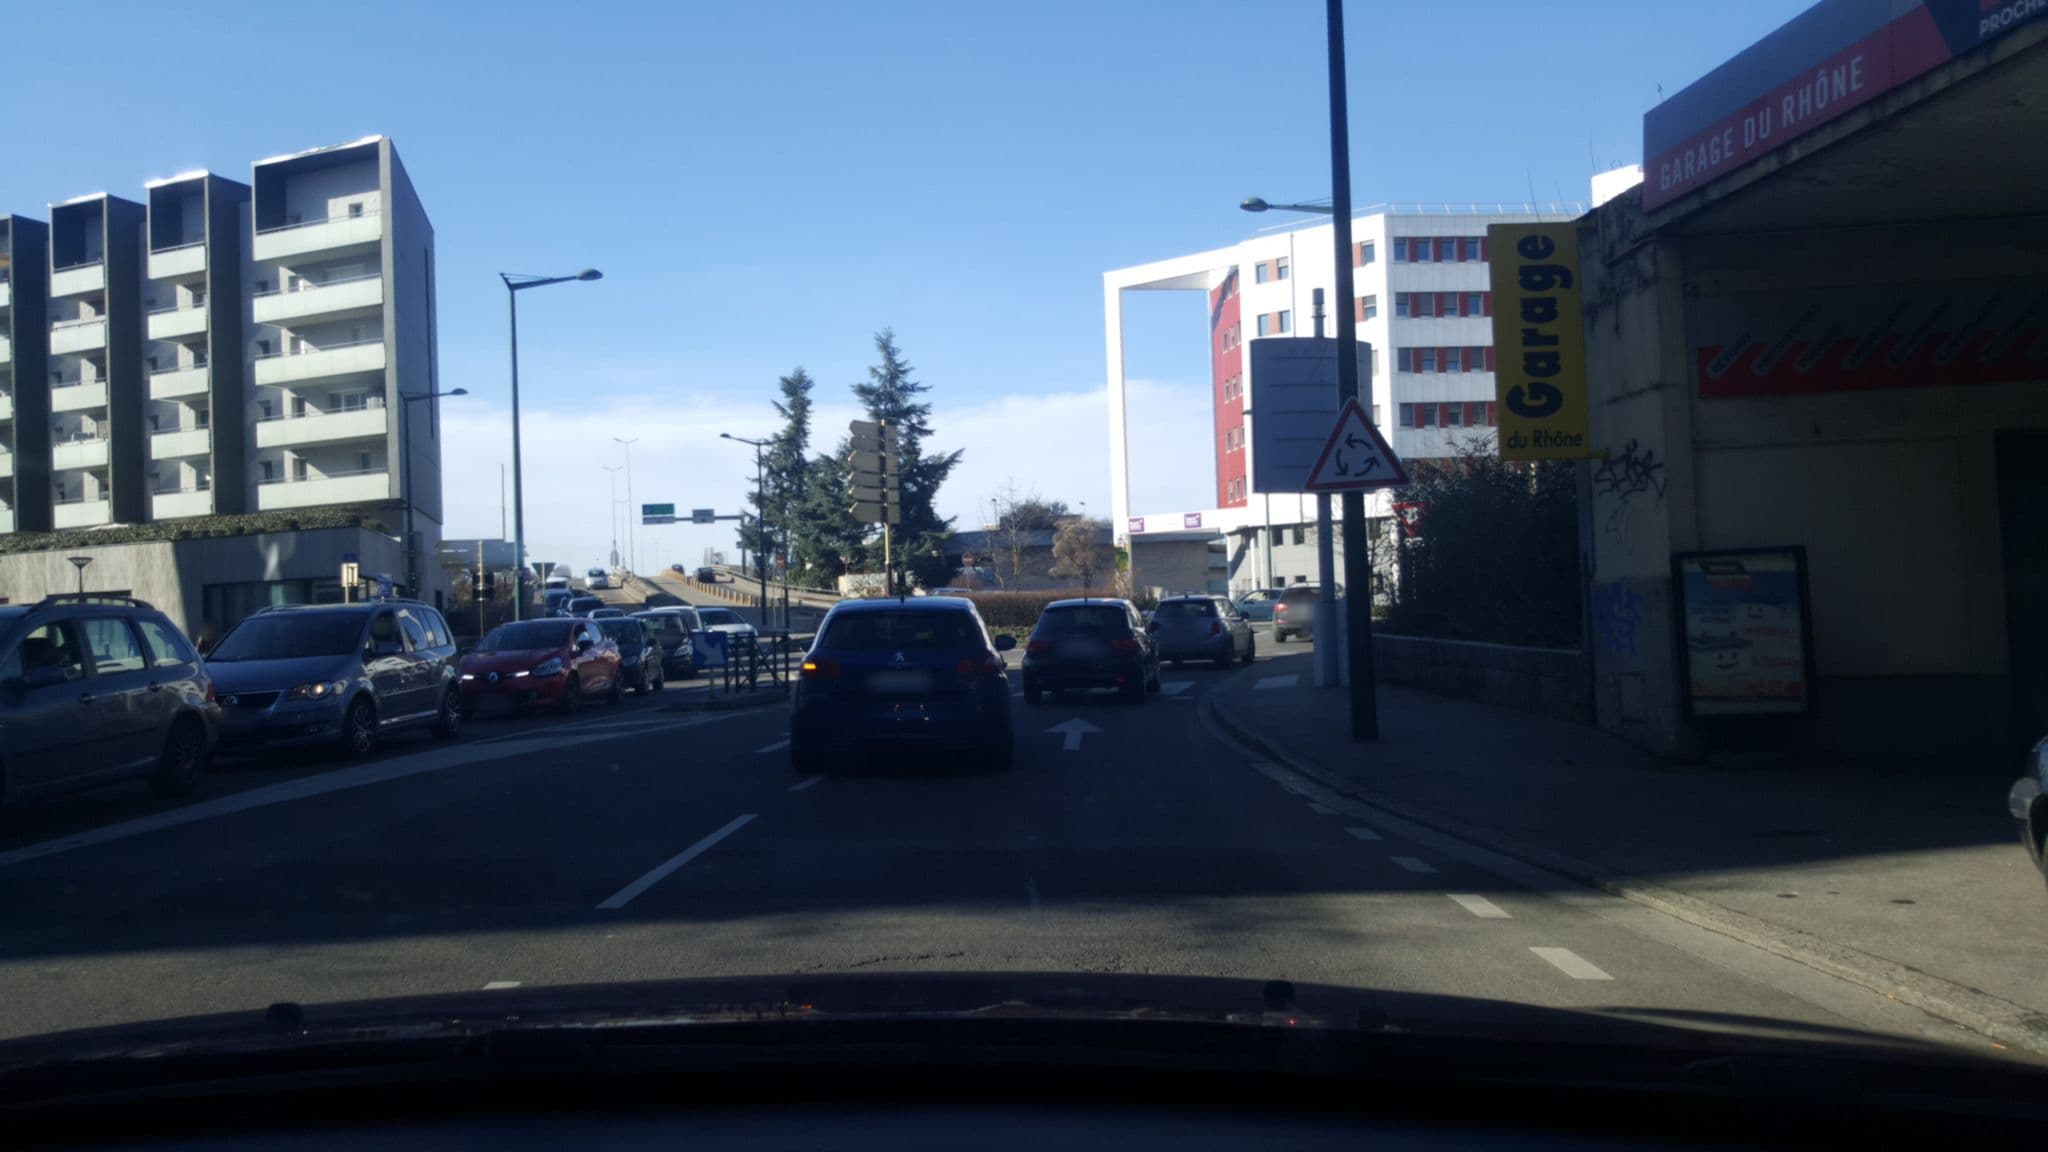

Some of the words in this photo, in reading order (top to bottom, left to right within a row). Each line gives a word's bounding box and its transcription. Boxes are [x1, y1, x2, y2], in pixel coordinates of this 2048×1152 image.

[1660, 127, 1734, 192] GARAGE
[1744, 106, 1771, 149] DU
[1782, 55, 1864, 129] RHÔNE
[1505, 234, 1573, 418] Garage
[1507, 431, 1527, 449] du
[1534, 429, 1583, 449] Rhône
